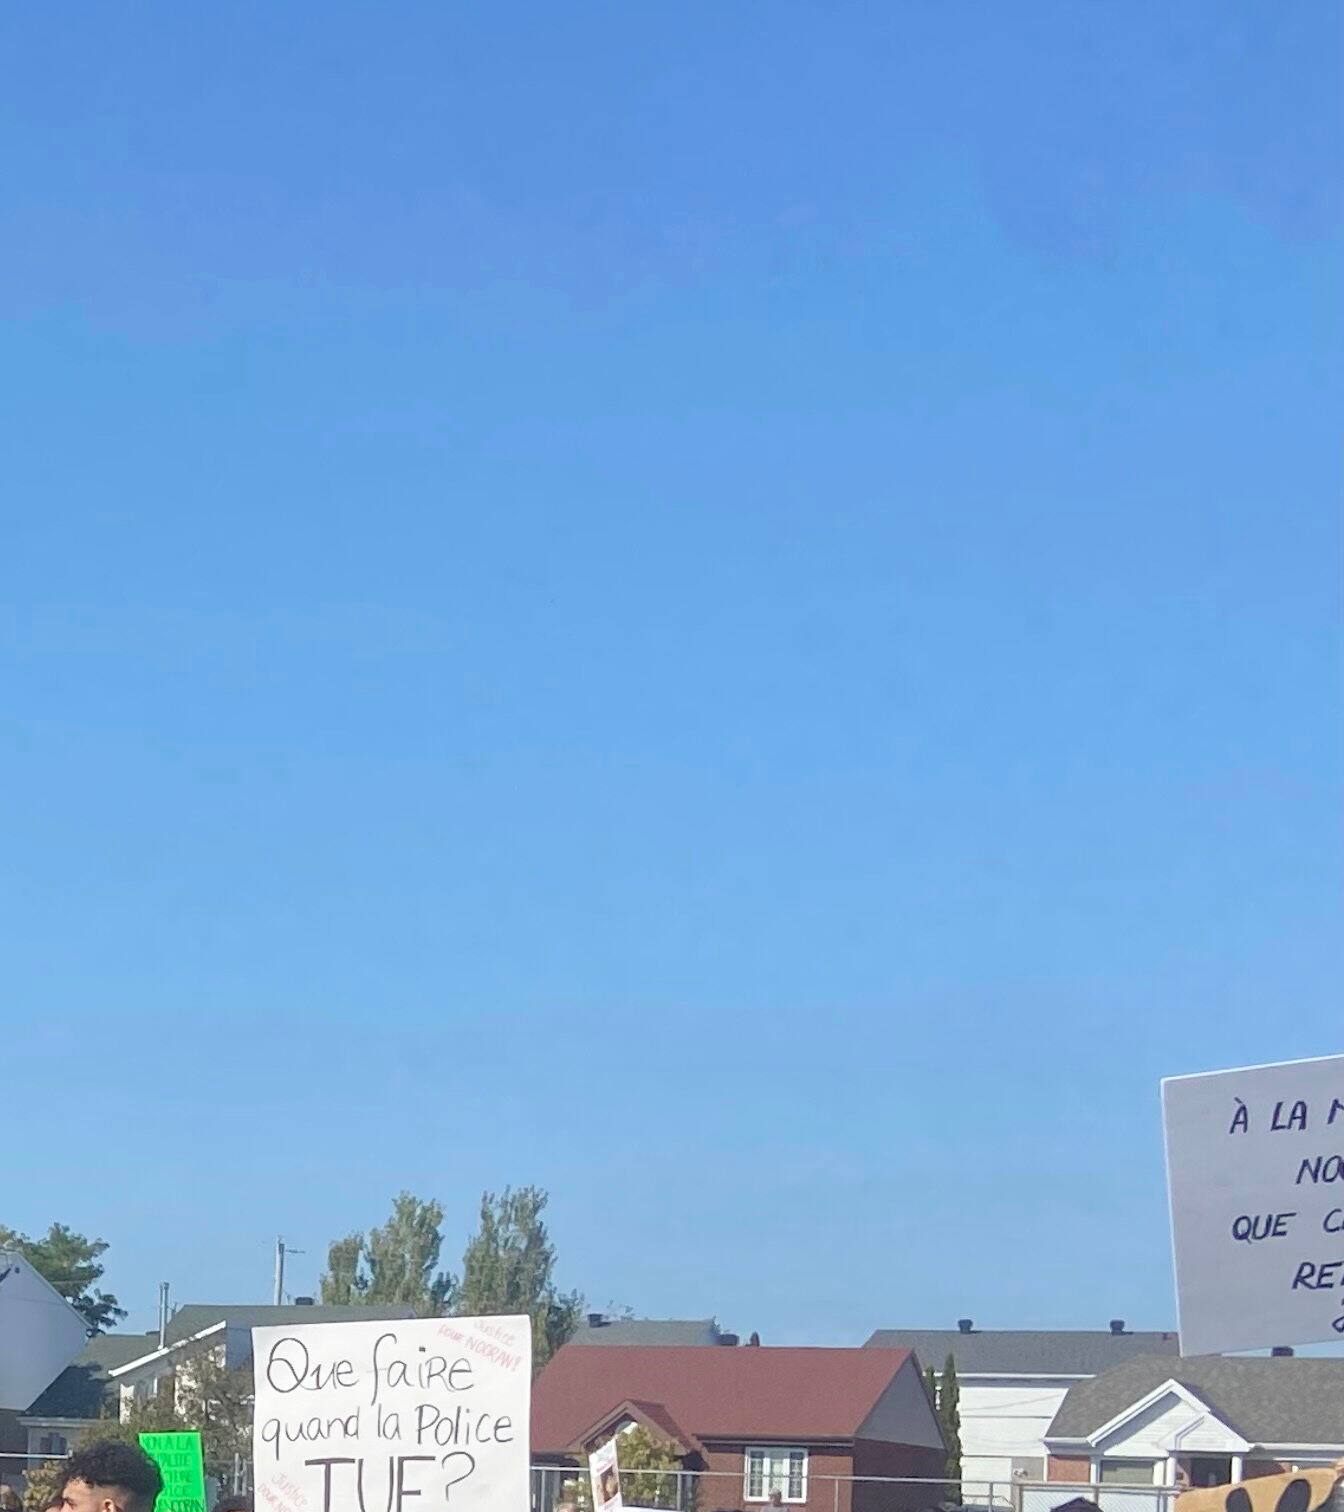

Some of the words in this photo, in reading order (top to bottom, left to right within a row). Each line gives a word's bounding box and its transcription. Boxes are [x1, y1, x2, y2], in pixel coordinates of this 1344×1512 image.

[1229, 1097, 1249, 1134] À
[1270, 1100, 1307, 1131] LA
[1232, 1212, 1297, 1244] QUE
[1323, 1208, 1344, 1233] C
[1292, 1261, 1344, 1290] RE
[266, 1337, 359, 1394] Que
[261, 1406, 360, 1461] quand
[378, 1402, 402, 1441] la
[415, 1403, 514, 1446] Police
